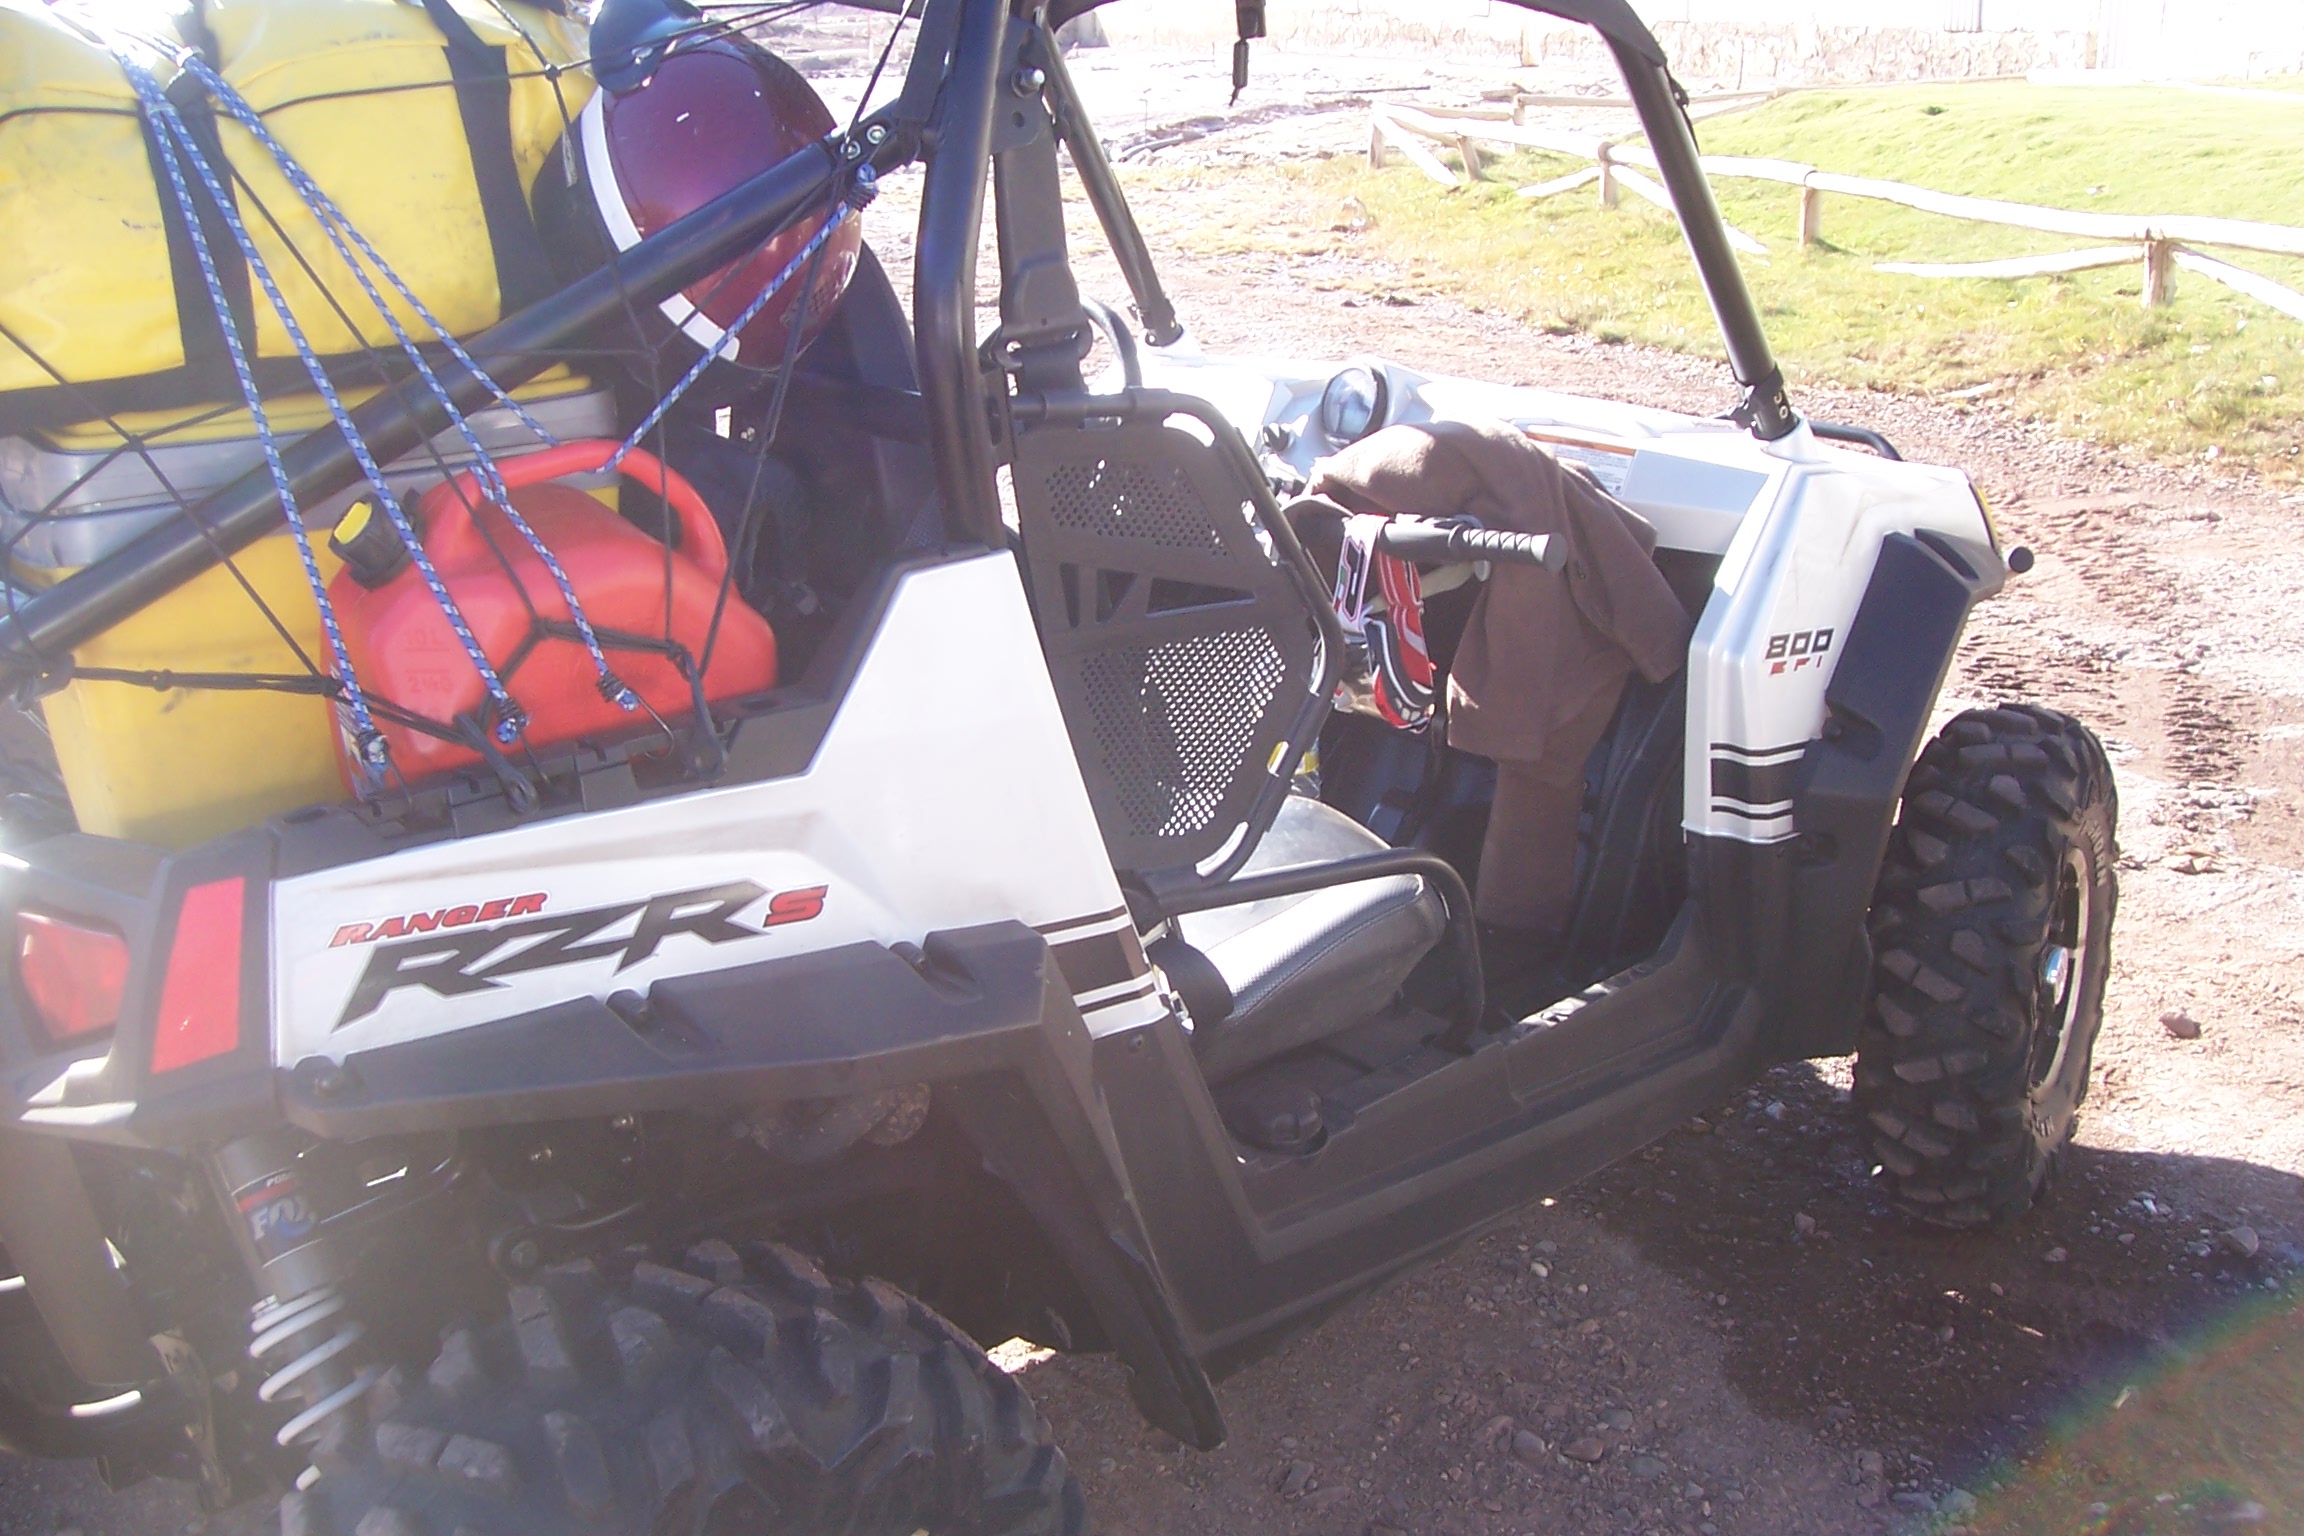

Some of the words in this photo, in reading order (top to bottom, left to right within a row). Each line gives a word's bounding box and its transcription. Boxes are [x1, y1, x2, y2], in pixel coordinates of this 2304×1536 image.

[1764, 627, 1835, 660] 800
[327, 892, 550, 948] RANGER
[329, 880, 770, 1034] RZR
